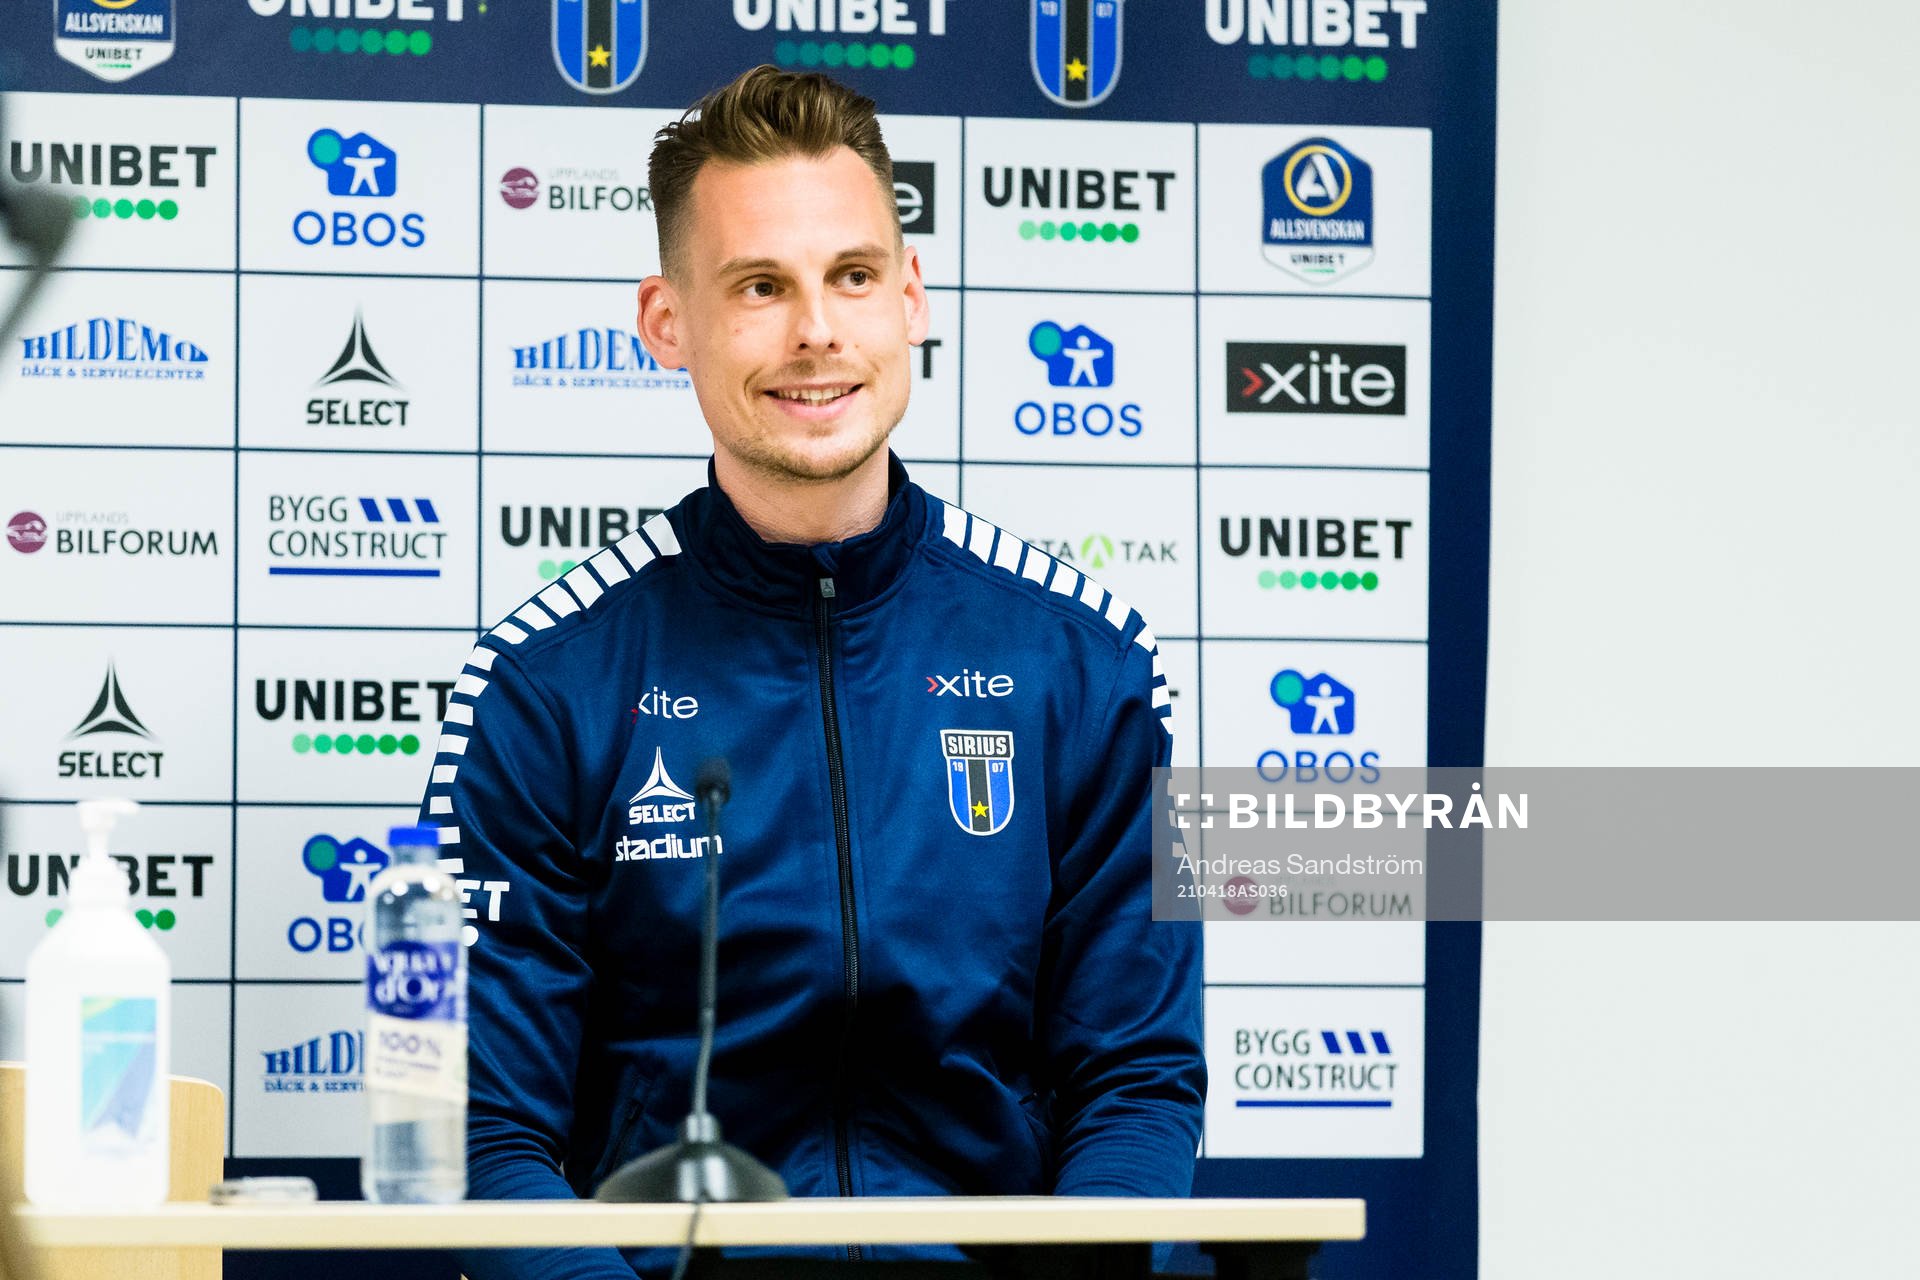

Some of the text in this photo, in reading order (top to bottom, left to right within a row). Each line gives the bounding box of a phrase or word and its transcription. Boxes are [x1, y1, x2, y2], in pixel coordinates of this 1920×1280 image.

[64, 12, 164, 34] ALLSVENSKAN
[1205, 0, 1428, 49] UNIBET
[10, 141, 217, 188] UNIBET
[549, 186, 652, 211] BILFOR
[983, 167, 1176, 212] UNIBET
[293, 211, 426, 248] OBOS
[1270, 218, 1365, 241] ALLSVENSKAN
[512, 327, 688, 371] BILDEM
[1260, 350, 1396, 406] xite
[306, 400, 410, 426] SELECT
[1015, 401, 1143, 437] OBOS
[269, 496, 347, 522] BYGG
[501, 506, 664, 548] UNIB
[1220, 517, 1413, 560] UNIBET
[56, 529, 219, 556] BILFORUM
[268, 531, 448, 559] CONSTRUCT
[1121, 541, 1178, 563] TAK
[935, 668, 1014, 698] xite
[256, 679, 455, 722] UNIBET
[947, 735, 1007, 756] SIRIUS
[58, 751, 164, 779] SELECT
[1256, 749, 1382, 785] OBOS
[629, 802, 696, 825] SELECT
[615, 833, 723, 862] stadium
[8, 854, 213, 898] UNBET
[1270, 892, 1413, 917] BILFORUM
[1235, 1029, 1311, 1056] BYGG
[1235, 1064, 1398, 1091] CONSTRUCT
